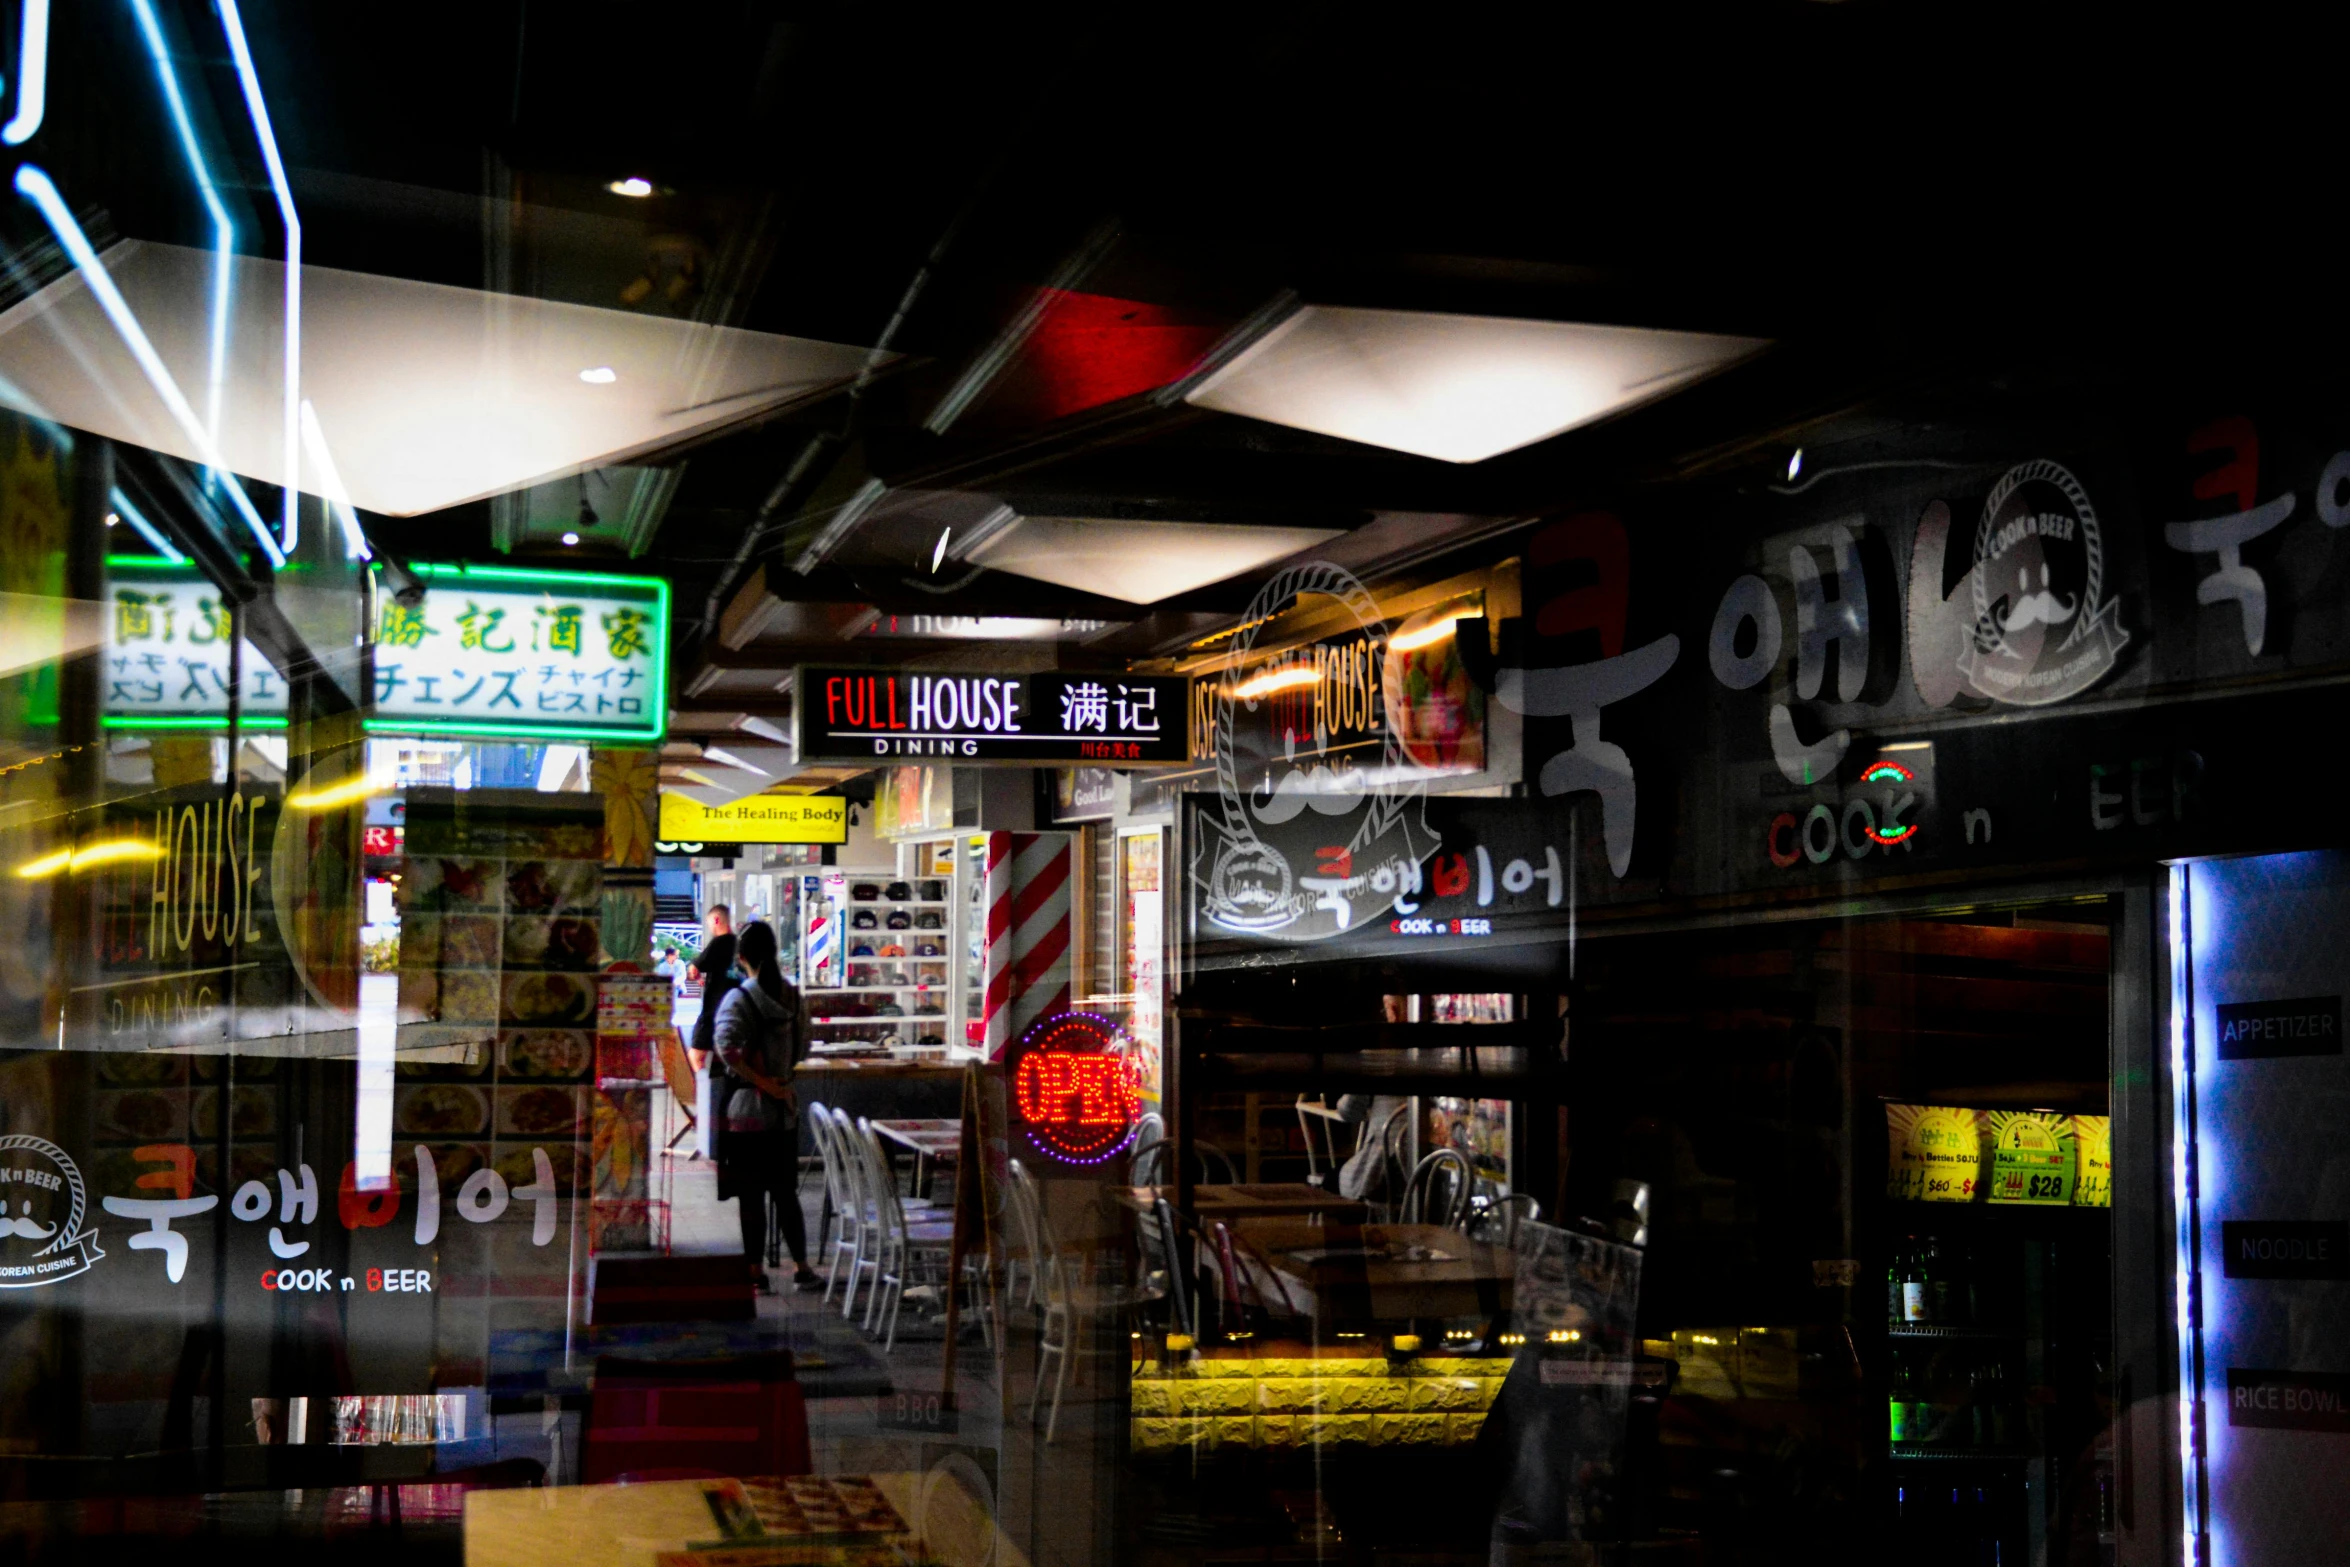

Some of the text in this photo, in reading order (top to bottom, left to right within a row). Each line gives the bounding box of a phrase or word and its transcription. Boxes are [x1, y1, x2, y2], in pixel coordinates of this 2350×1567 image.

[1313, 638, 1380, 741] HOUSE
[1059, 682, 1160, 732] 满记
[874, 739, 979, 756] DINING
[703, 806, 843, 822] The Healing Body
[149, 792, 265, 961] HOUSE
[1391, 918, 1434, 935] COOK
[1450, 918, 1492, 935] BEER
[2223, 1013, 2335, 1043] APPETIZER
[1926, 1152, 1954, 1163] Bottles
[1956, 1153, 1979, 1164] SOJU
[25, 1168, 62, 1192] BEER
[1928, 1177, 1950, 1193] $60
[2029, 1173, 2063, 1198] $28
[2241, 1237, 2330, 1262] NOODLE
[37, 1256, 77, 1273] CUISINE
[261, 1269, 332, 1292] COOK
[366, 1268, 431, 1293] BEER
[896, 1393, 939, 1424] BBQ
[2234, 1385, 2279, 1410] RICE
